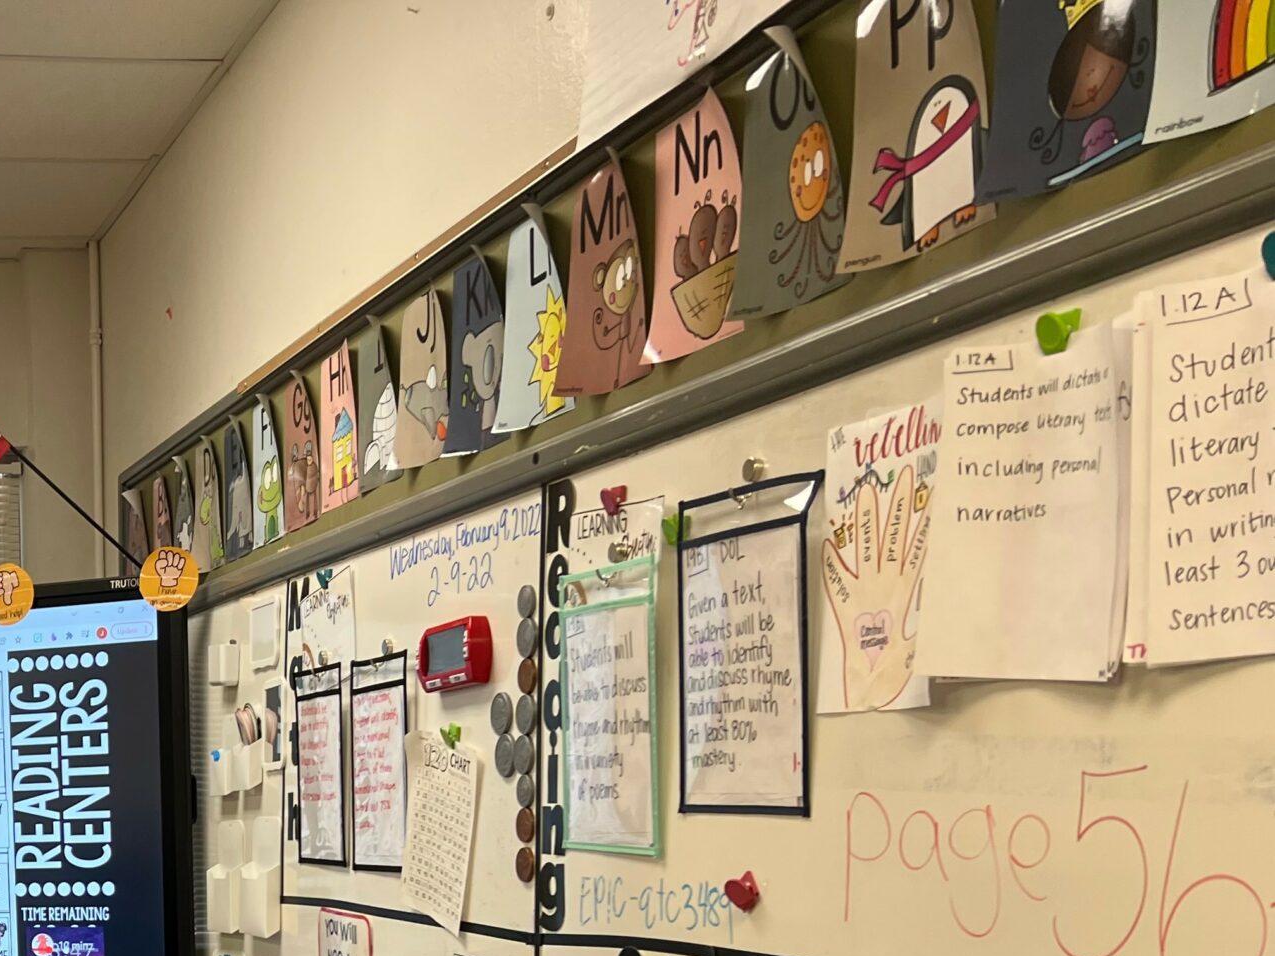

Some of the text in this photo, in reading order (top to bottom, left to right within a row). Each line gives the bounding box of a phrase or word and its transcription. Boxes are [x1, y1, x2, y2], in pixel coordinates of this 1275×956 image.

[674, 110, 723, 196] Nn
[1169, 378, 1268, 423] dictate
[957, 420, 1030, 440] compose
[1171, 431, 1260, 468] literary
[957, 457, 1045, 485] including
[957, 503, 1047, 523] narratives
[1167, 526, 1193, 549] in
[1165, 550, 1250, 586] least 3
[9, 682, 62, 869] READING
[59, 679, 112, 869] CENTERS
[844, 791, 1051, 938] page
[21, 906, 110, 922] TIME REMAINING
